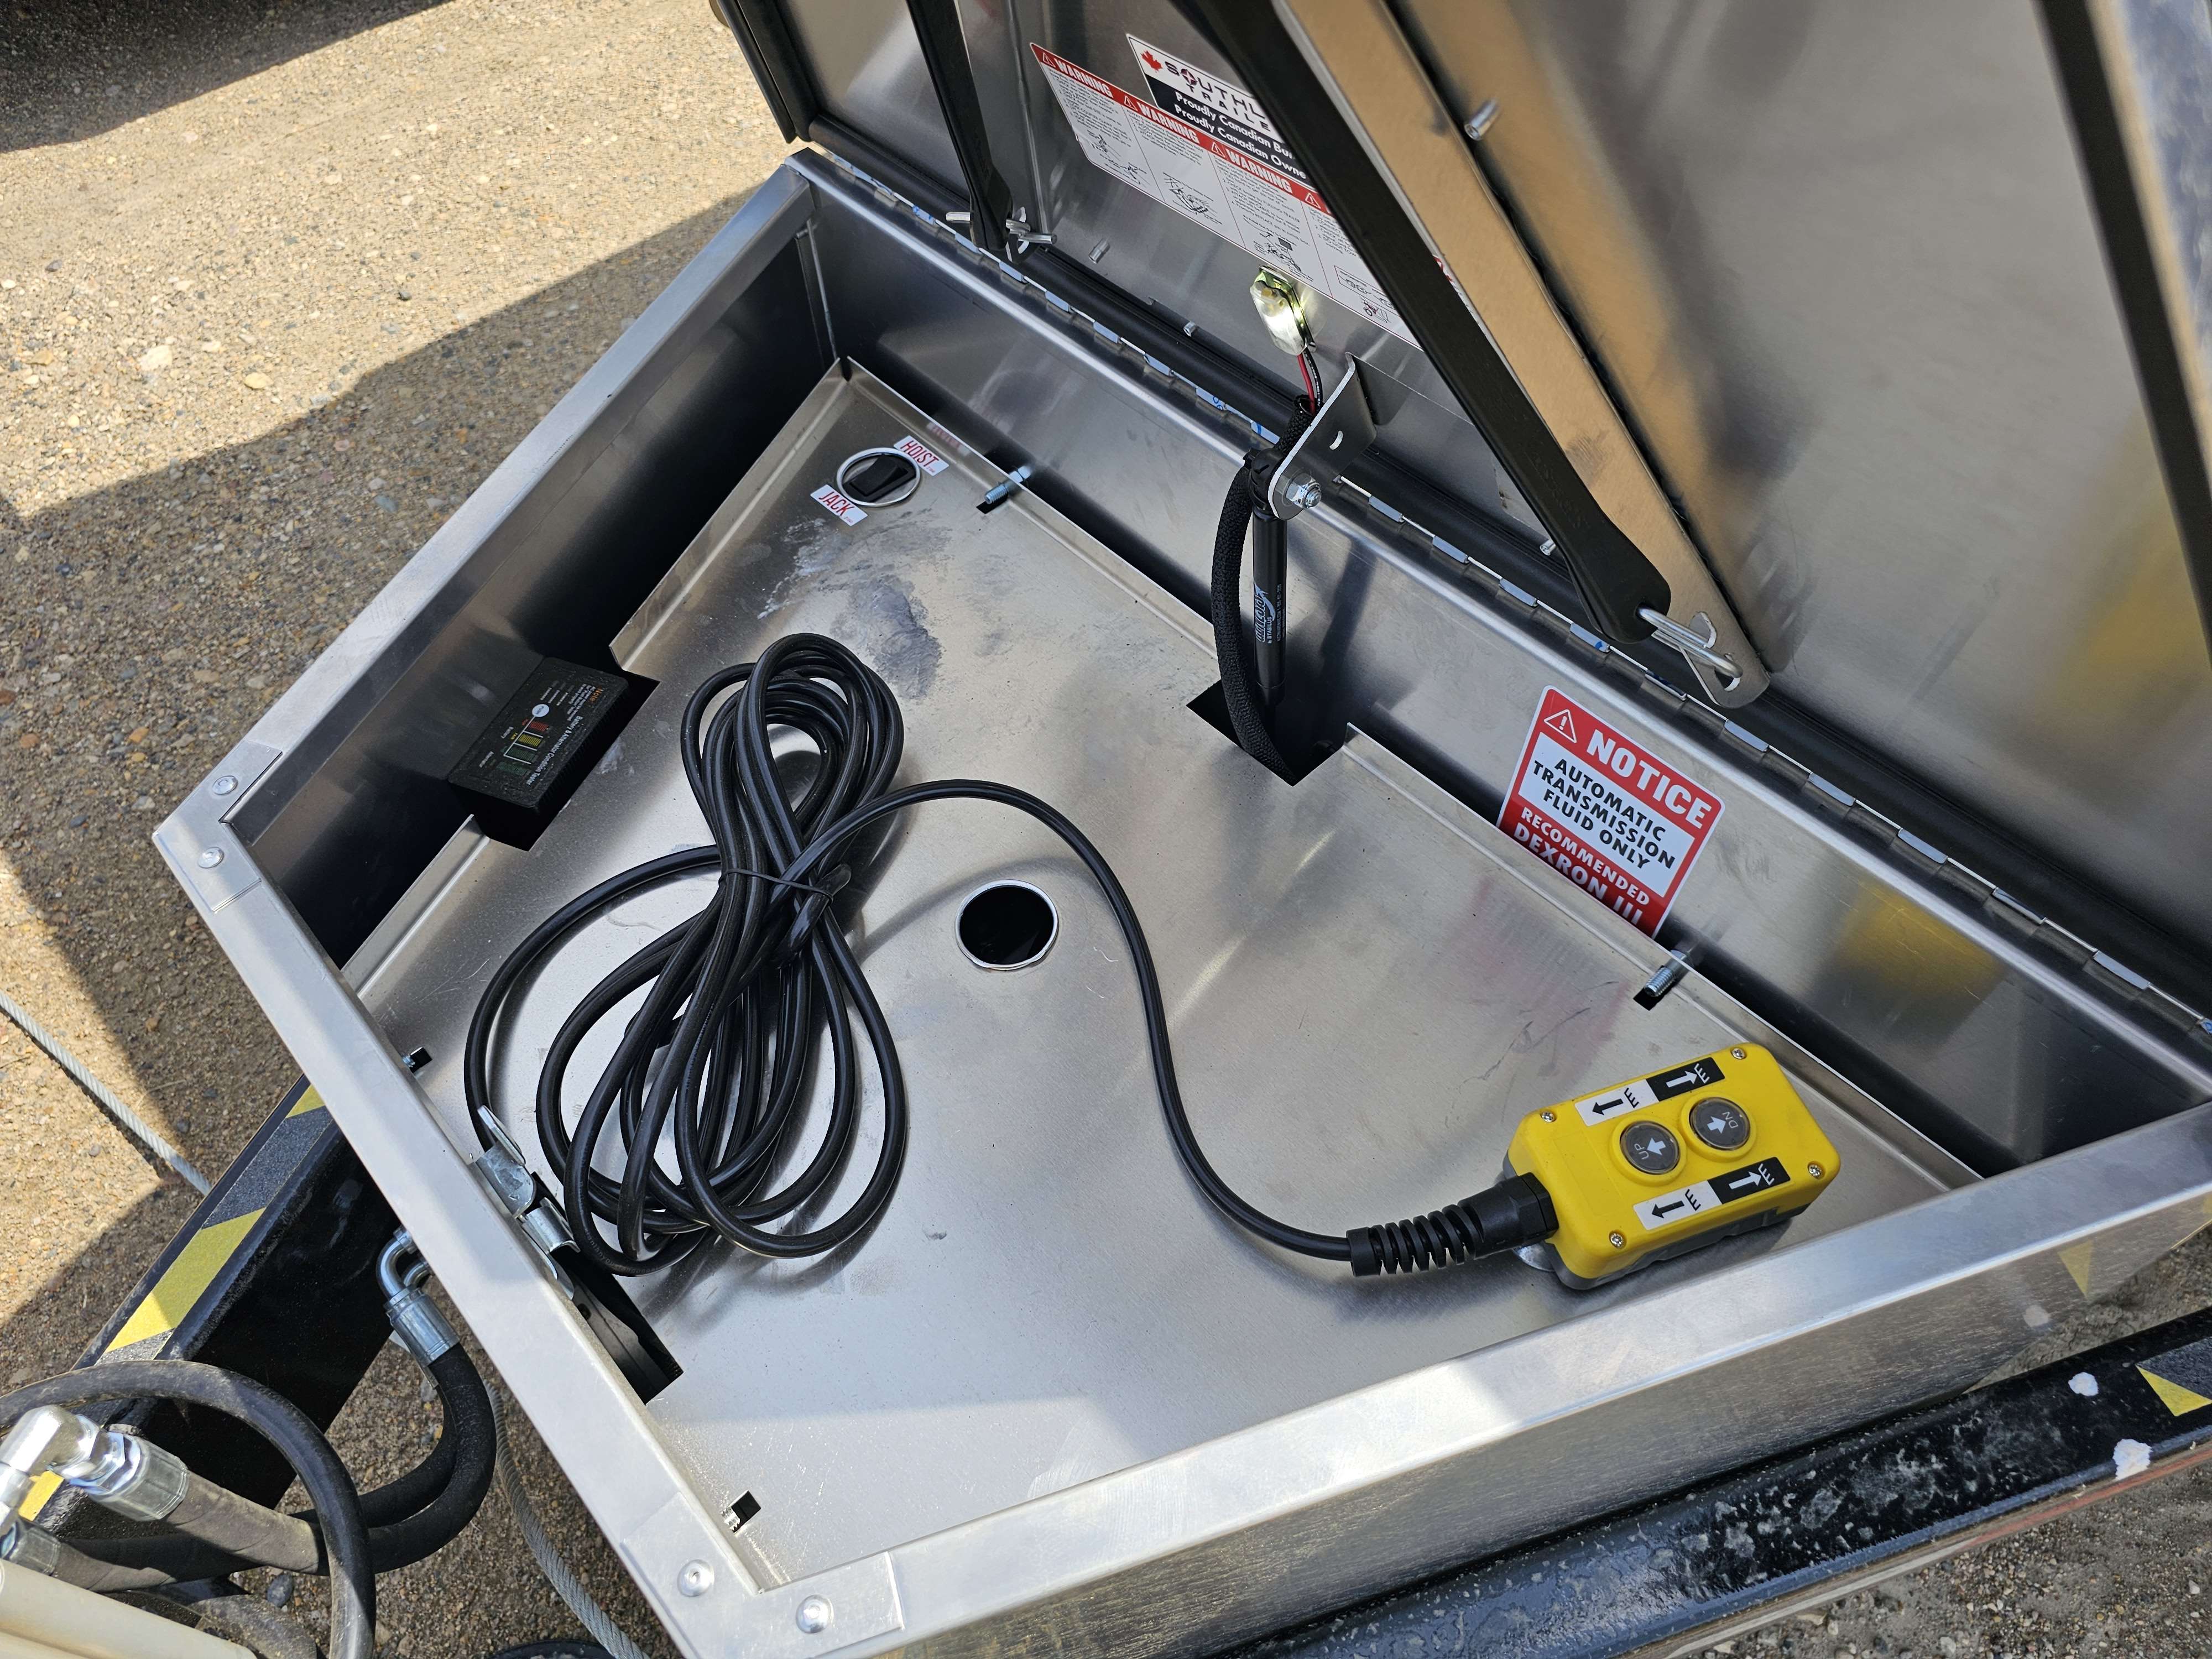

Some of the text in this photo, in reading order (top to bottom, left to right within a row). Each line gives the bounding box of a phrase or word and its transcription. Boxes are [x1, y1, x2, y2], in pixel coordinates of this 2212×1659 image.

[1054, 59, 1113, 98] WARNING
[1137, 102, 1200, 144] WARNING
[1174, 104, 1214, 133] Proudly
[1218, 127, 1269, 160] Canadian
[1175, 92, 1216, 121] Proudly
[1219, 114, 1271, 148] Canadian
[1225, 149, 1293, 194] WARNING
[900, 440, 939, 467] HOIST
[818, 492, 854, 516] JACK
[567, 716, 583, 730] Battery
[526, 773, 540, 785] Tester
[536, 753, 554, 773] Condition
[1587, 729, 1712, 828] NOTICE
[1533, 761, 1675, 869] TRANSMISSION
[1554, 759, 1666, 841] AUTOMATIC
[1543, 789, 1651, 869] FLUID ONLY
[1513, 822, 1642, 925] DEXRON III
[1521, 807, 1650, 905] RECOMMENDED
[1723, 1111, 1739, 1129] DN
[1634, 1143, 1649, 1161] UP
